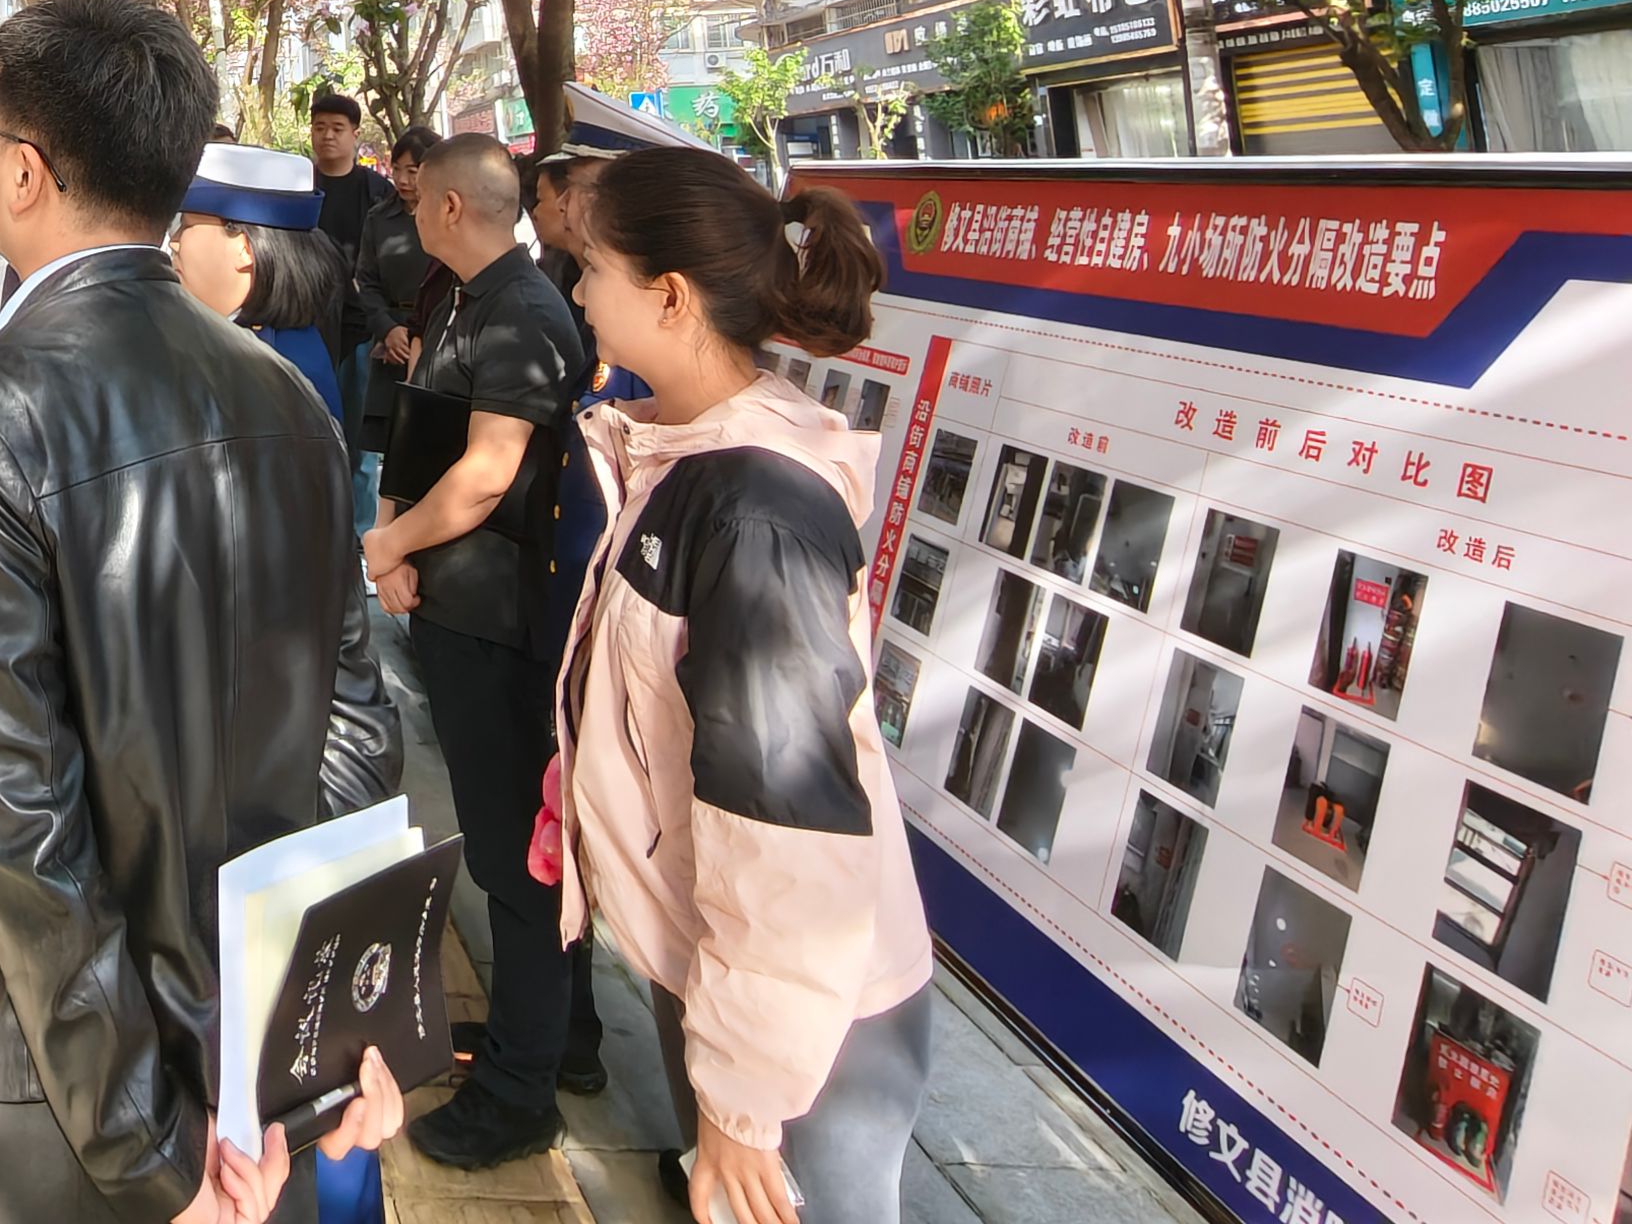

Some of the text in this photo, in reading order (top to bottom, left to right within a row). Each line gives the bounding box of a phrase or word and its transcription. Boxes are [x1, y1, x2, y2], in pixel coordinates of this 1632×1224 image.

[1066, 426, 1111, 455] 改造前
[1172, 399, 1496, 505] 改造前后对比图
[1435, 528, 1517, 572] 改造后
